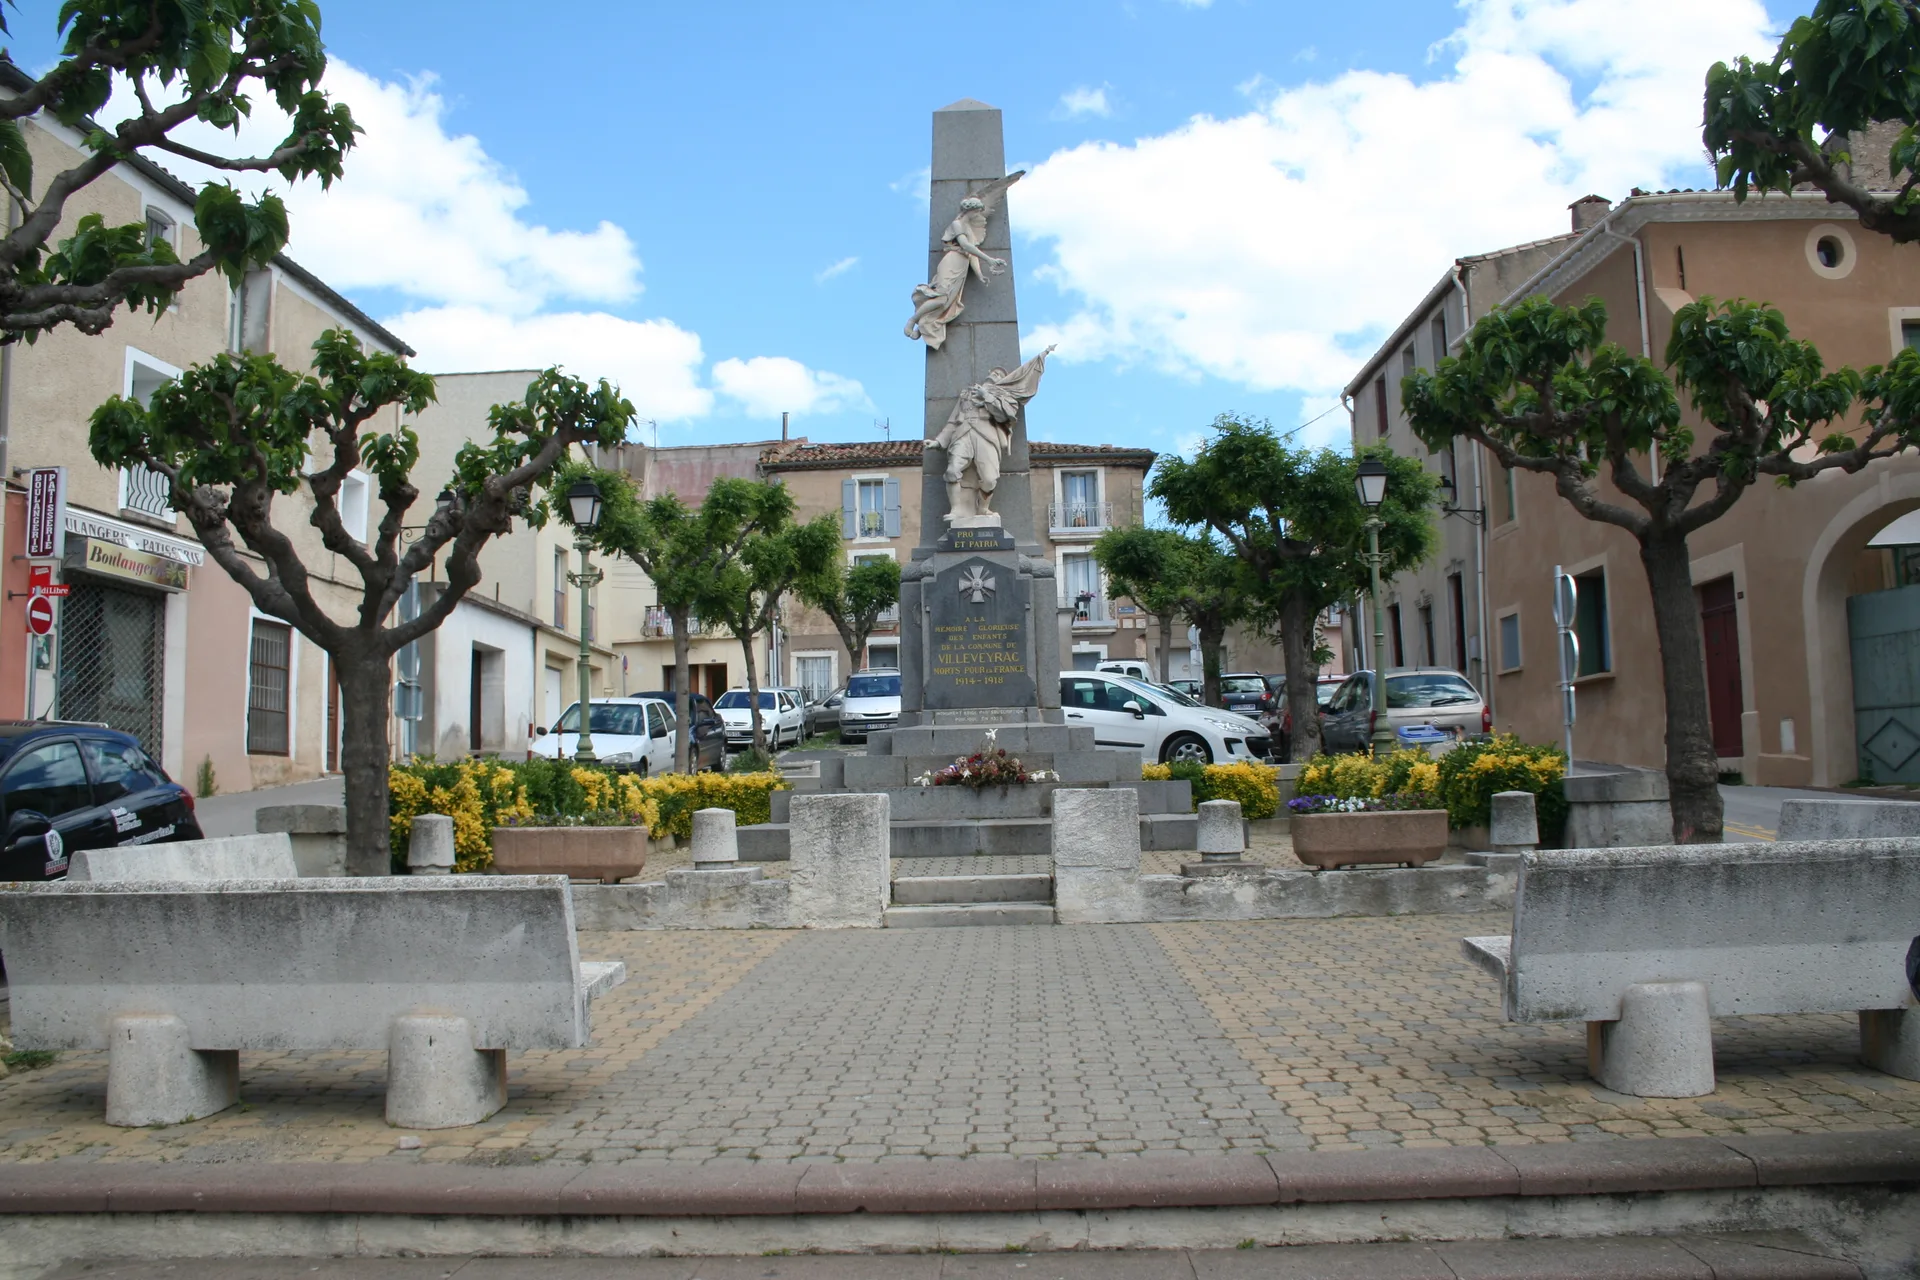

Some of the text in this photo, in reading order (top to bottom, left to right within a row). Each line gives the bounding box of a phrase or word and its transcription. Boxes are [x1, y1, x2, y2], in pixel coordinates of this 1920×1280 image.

[31, 474, 43, 553] BOULANGERIE
[45, 473, 56, 550] PATISSERIE
[65, 517, 131, 545] ULANGERI
[143, 539, 201, 564] PATISSRIE
[954, 540, 999, 549] ET PATRIA
[50, 586, 69, 594] Libre
[938, 651, 1020, 664] VILLEVEYRAC
[933, 667, 961, 675] MORTS
[964, 666, 985, 674] POUR
[994, 665, 1025, 673] FRANCE
